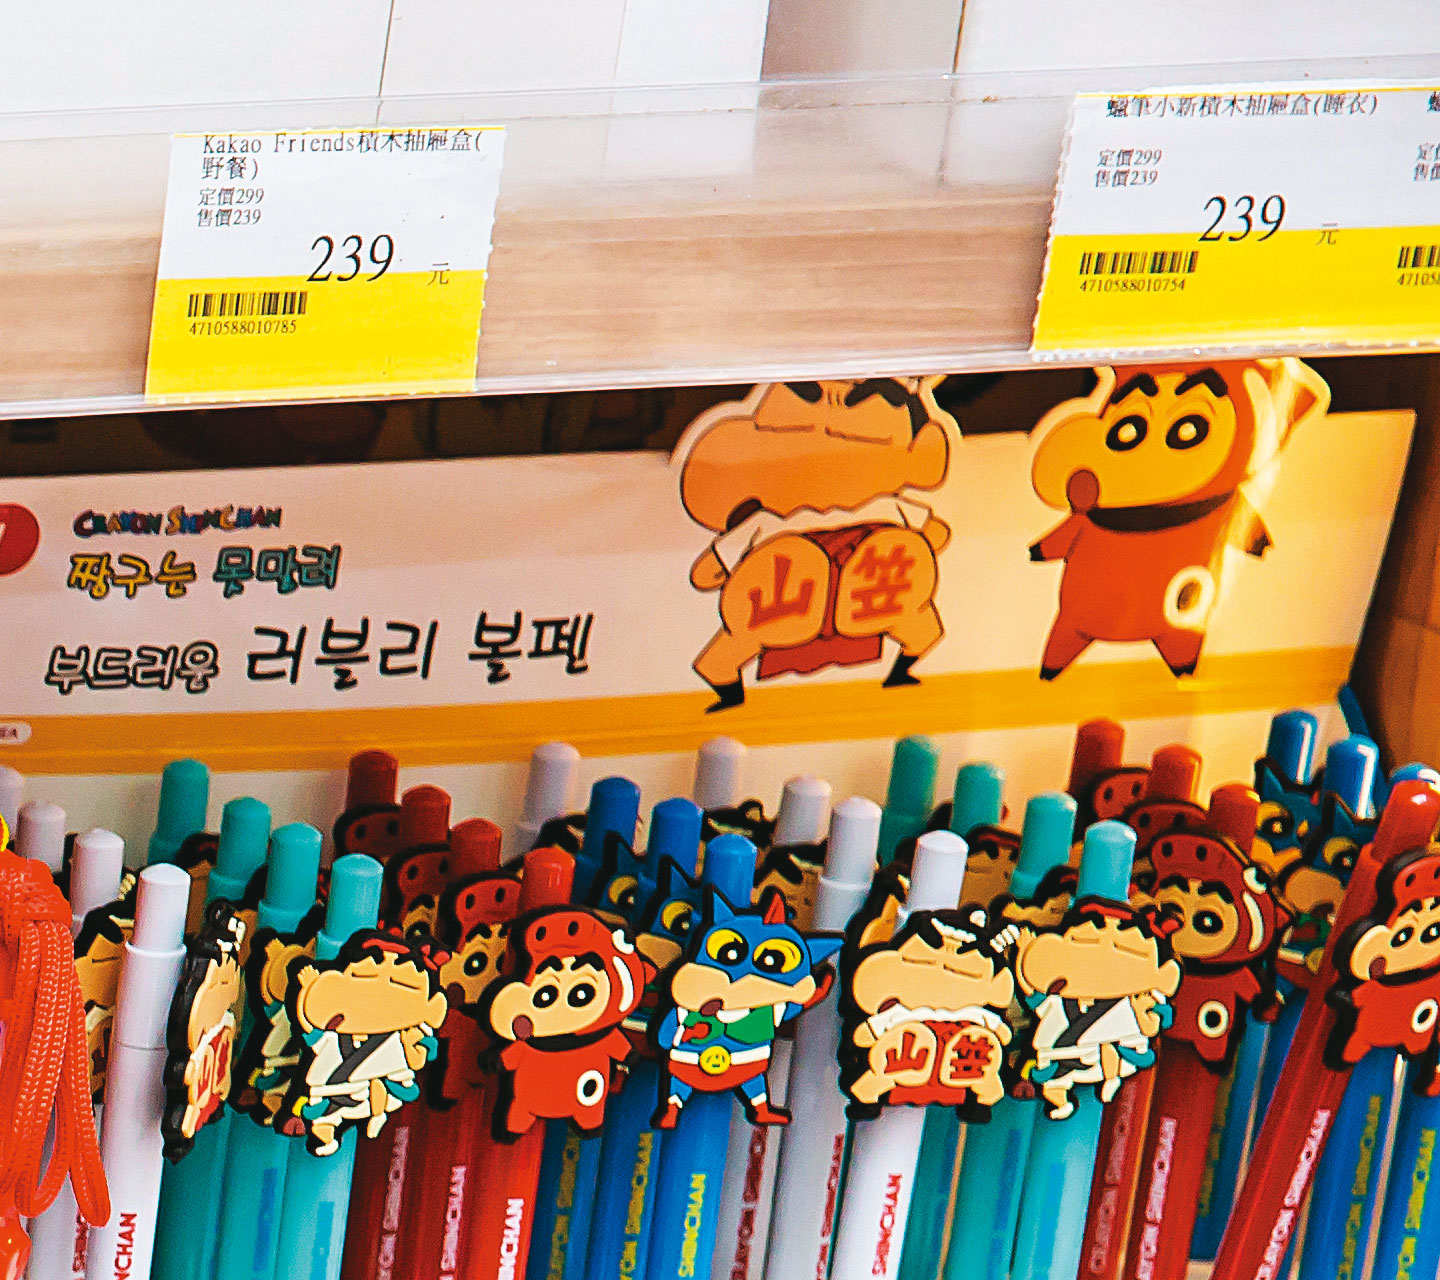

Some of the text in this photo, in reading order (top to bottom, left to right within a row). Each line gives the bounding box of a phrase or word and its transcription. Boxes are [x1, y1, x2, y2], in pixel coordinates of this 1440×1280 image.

[203, 134, 261, 154] Kakao
[1199, 195, 1340, 246] 239 元
[307, 234, 450, 286] 239 元
[246, 611, 593, 690] 러블리 볼펜
